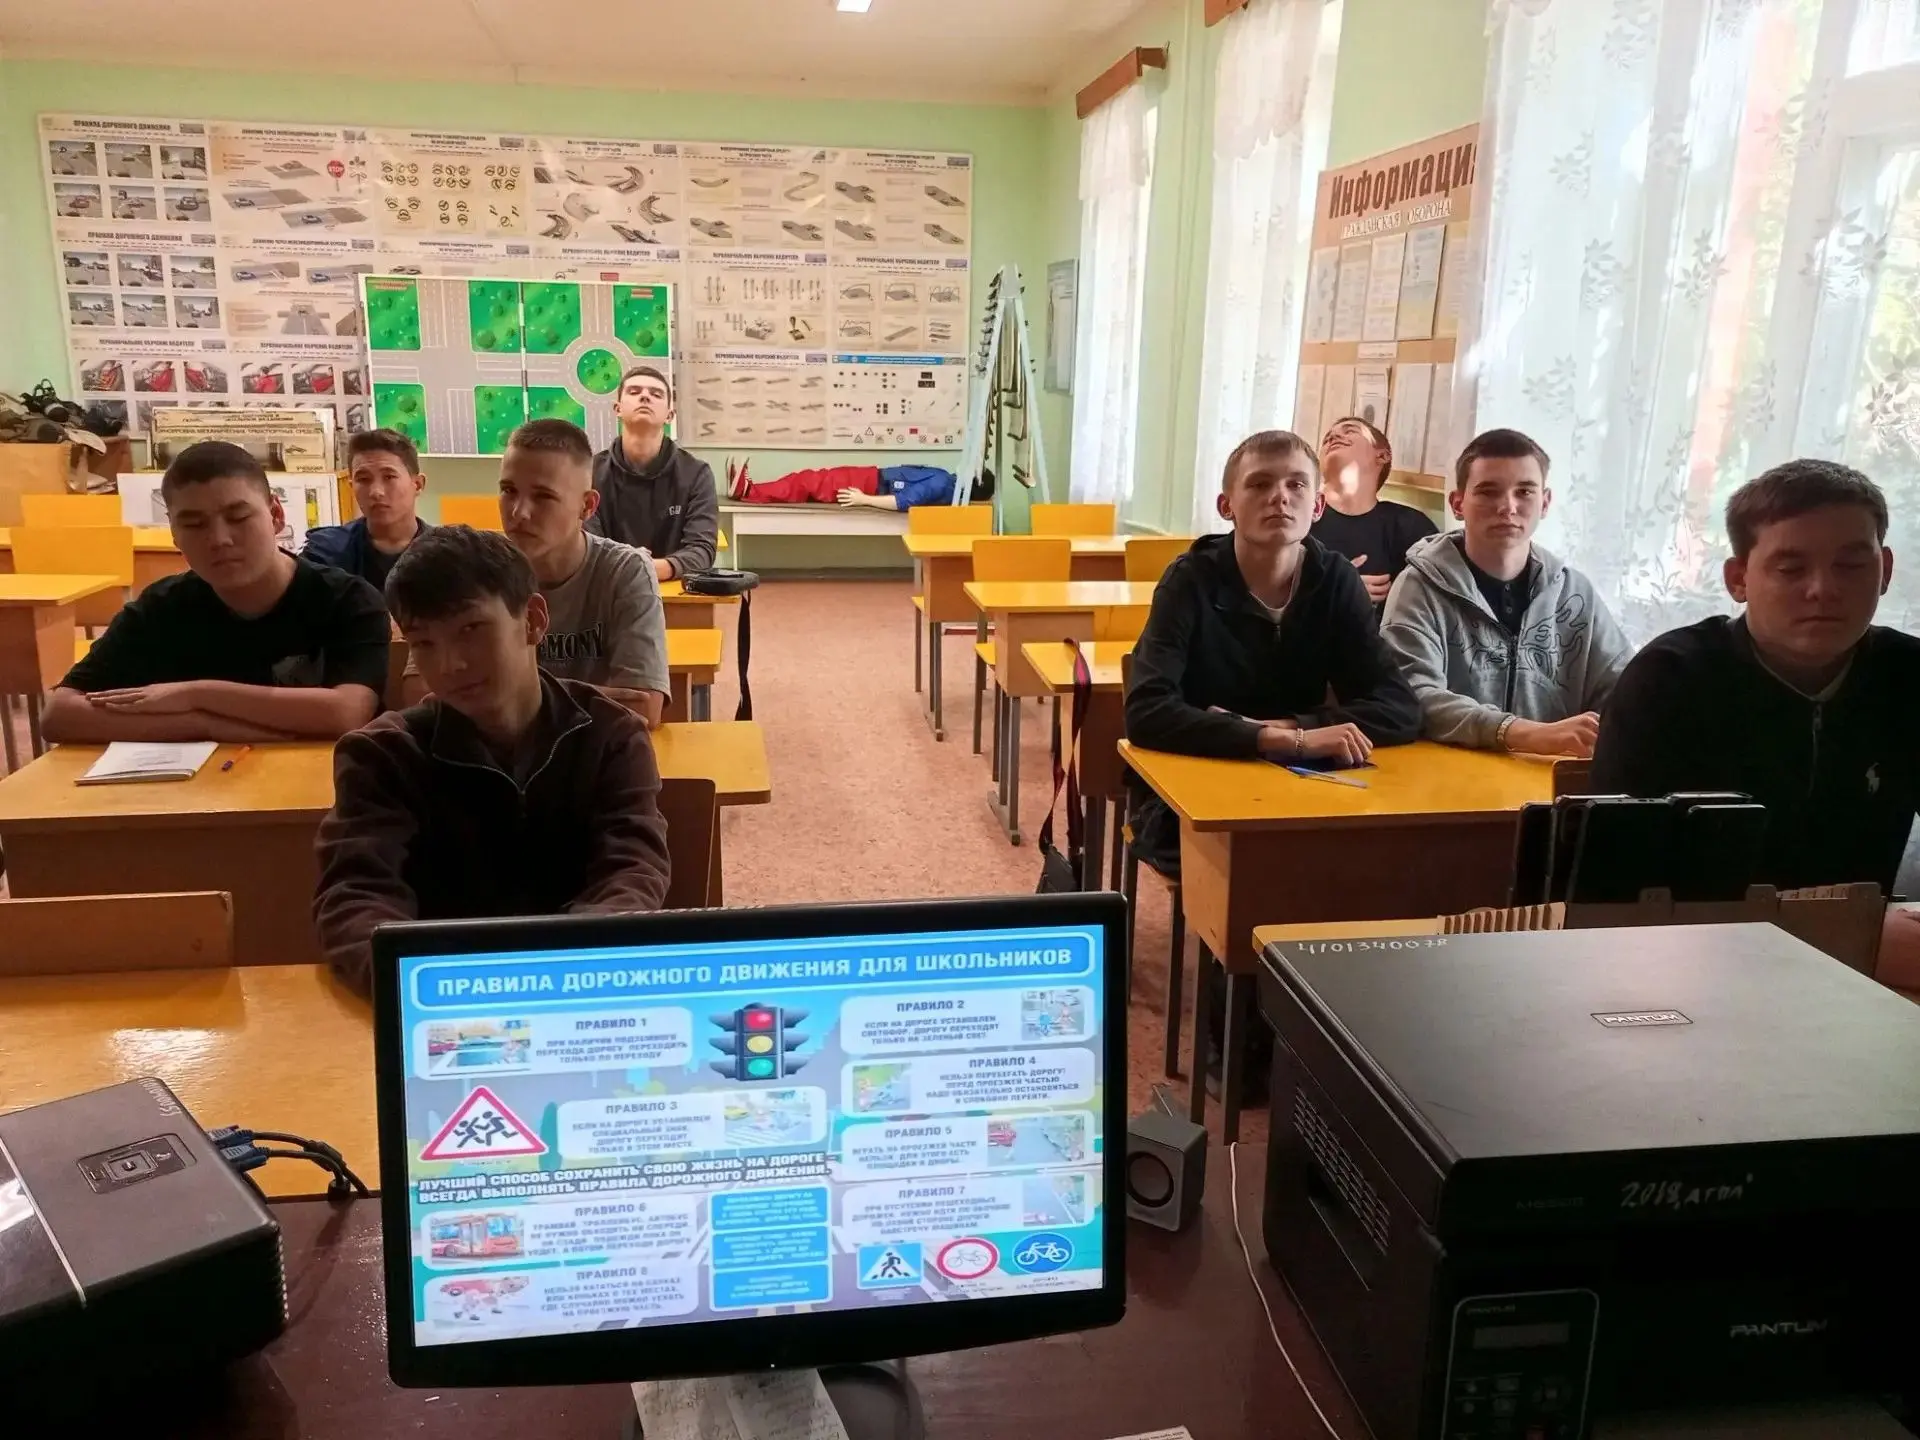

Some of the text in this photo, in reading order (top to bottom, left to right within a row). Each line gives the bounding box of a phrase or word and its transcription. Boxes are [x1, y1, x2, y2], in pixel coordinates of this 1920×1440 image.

[437, 948, 1073, 997] ПРАВИЛА ДОРОЖНОГО ДВИЖЕНИЯ ДЛЯ ШКОЛЬНИКОВ
[897, 1000, 964, 1012] ПРАВИЛО 2
[576, 1018, 646, 1030] ПРАВИЛО 1
[1603, 1013, 1681, 1024] PANTUM
[969, 1057, 1025, 1068] ПРАВИЛО
[606, 1102, 678, 1114] ПРАВИЛО 3
[885, 1126, 952, 1138] ПРАВИЛО 5
[419, 1153, 825, 1190] ЛУЧШИЙ СПОСОБ СОХРАНИТЬ СВОЮ ЖИЗНЬ НА ДОРОГЕ
[419, 1164, 831, 1204] ВСЕГДА ВЫПОЛНЯТЬ ПРАВИЛА ДОРОЖНОГО ДВИЖЕНИЯ.
[899, 1186, 965, 1199] ПРАВИЛО 7
[575, 1203, 646, 1216] ПРАВИЛО 6
[577, 1268, 636, 1280] ПРАВИЛО
[1729, 1319, 1828, 1339] PANTUM
